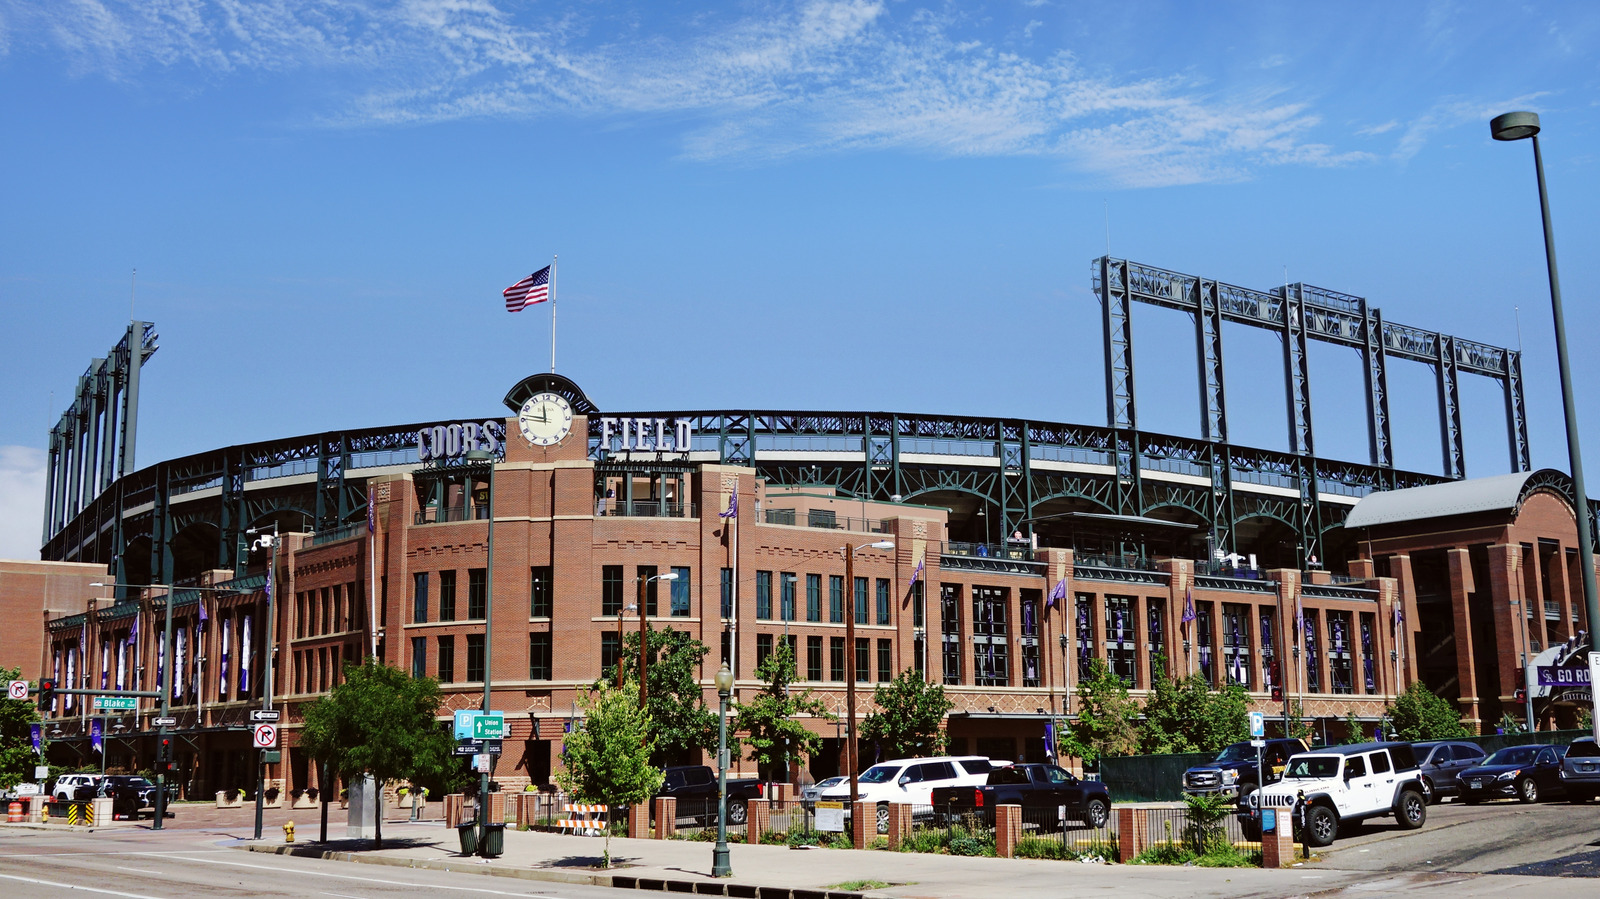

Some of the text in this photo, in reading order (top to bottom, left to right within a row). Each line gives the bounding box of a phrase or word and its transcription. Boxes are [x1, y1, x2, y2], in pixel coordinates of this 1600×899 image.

[417, 417, 691, 460] COORS FIELD
[1558, 670, 1572, 682] GO
[104, 700, 125, 708] Blake
[463, 716, 470, 725] P
[1253, 715, 1261, 732] P
